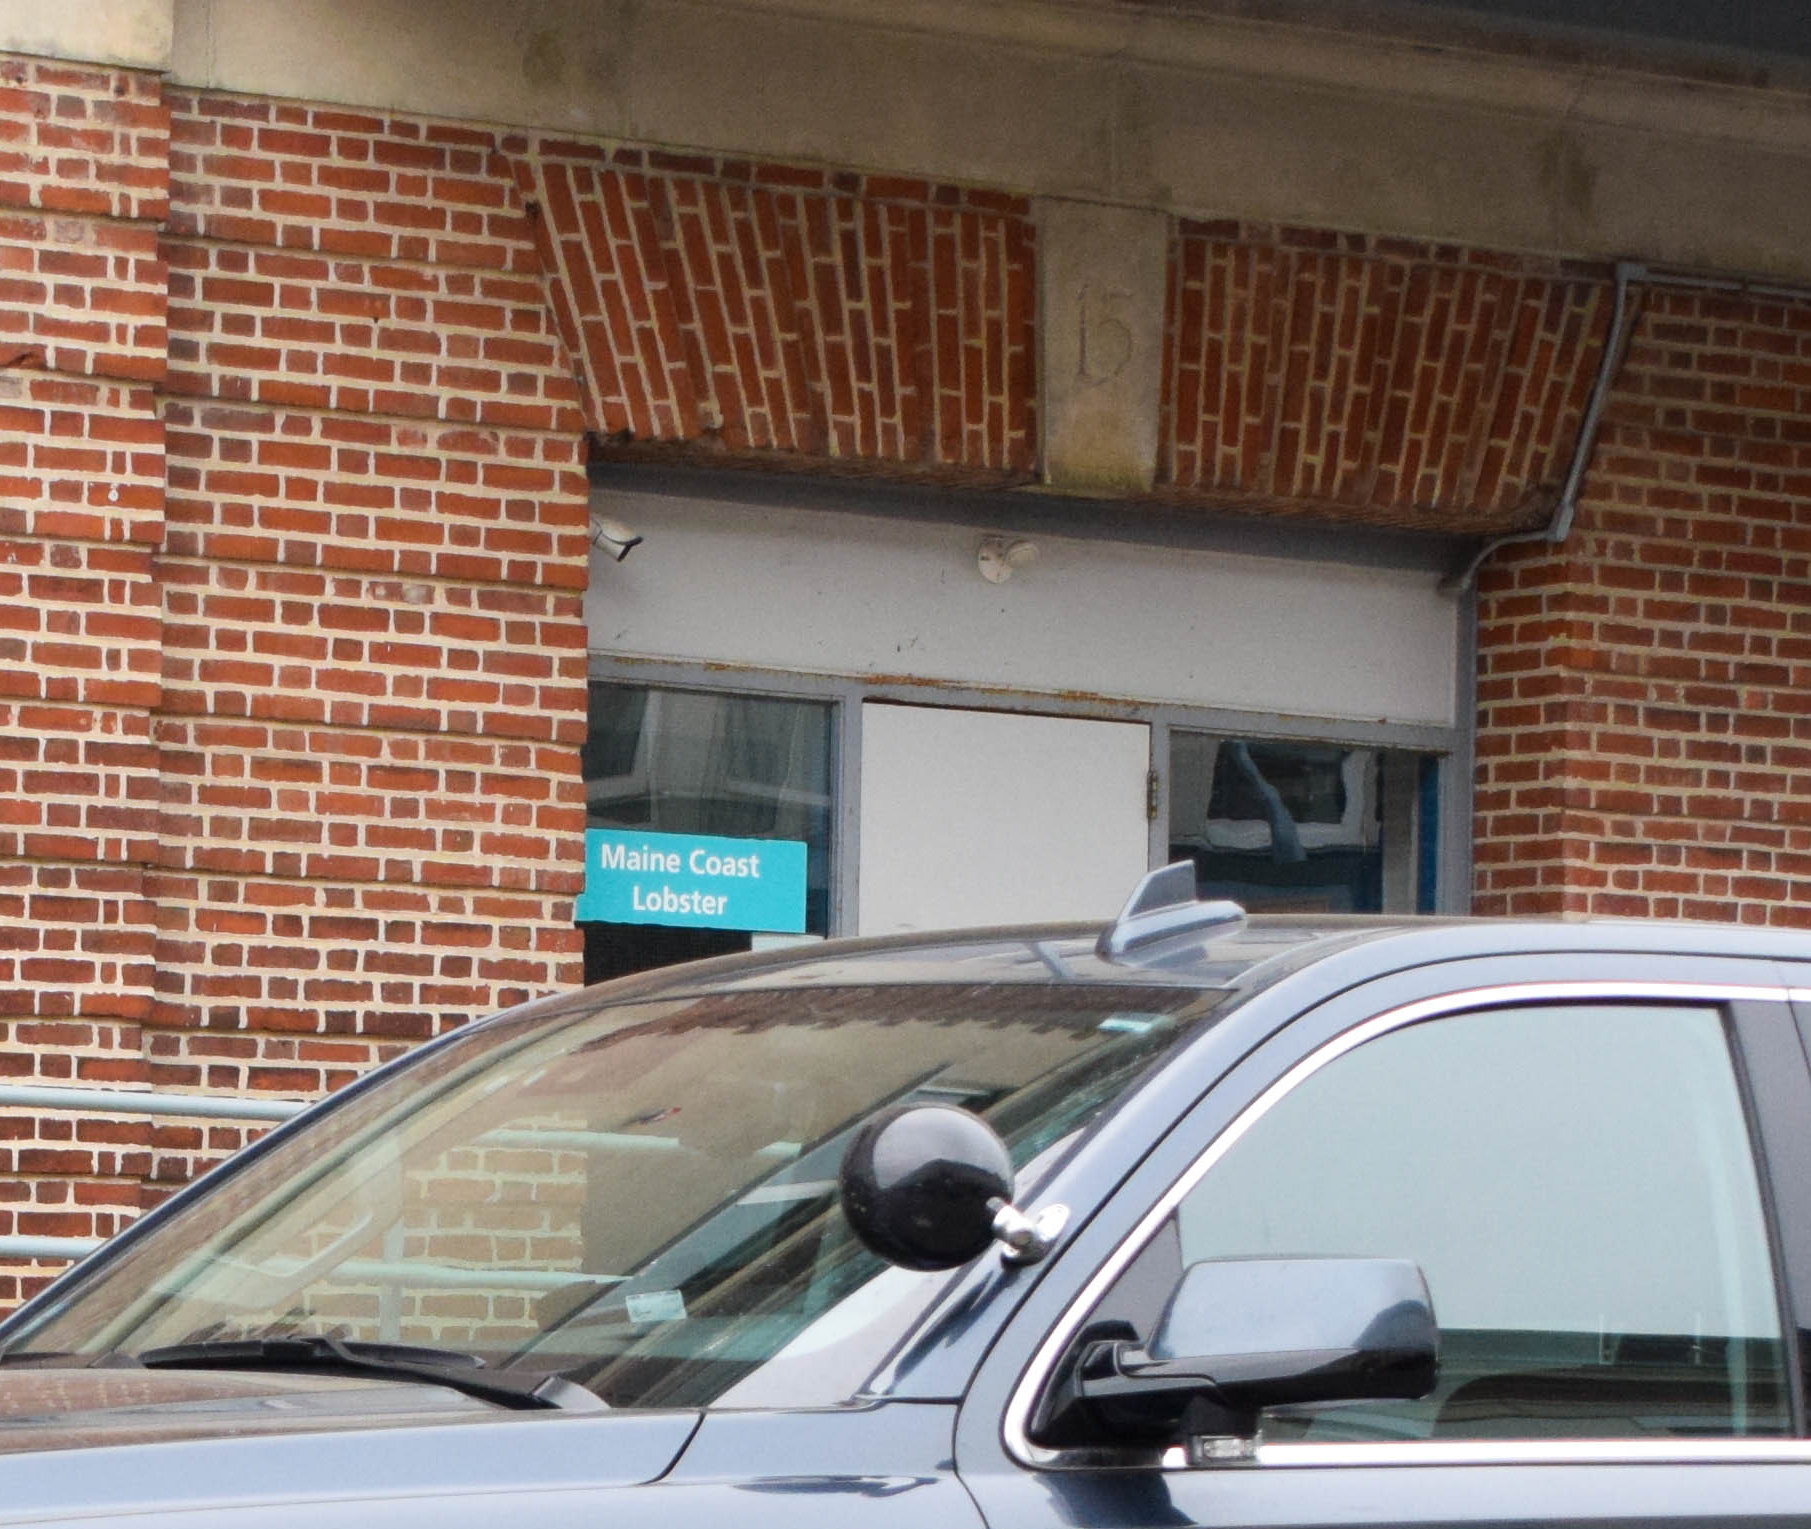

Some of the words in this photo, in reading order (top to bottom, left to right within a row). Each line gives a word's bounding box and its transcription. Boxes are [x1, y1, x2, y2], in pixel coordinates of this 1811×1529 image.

[600, 843, 682, 874] Maine
[689, 849, 760, 879] Coast
[631, 885, 728, 916] Lobster
